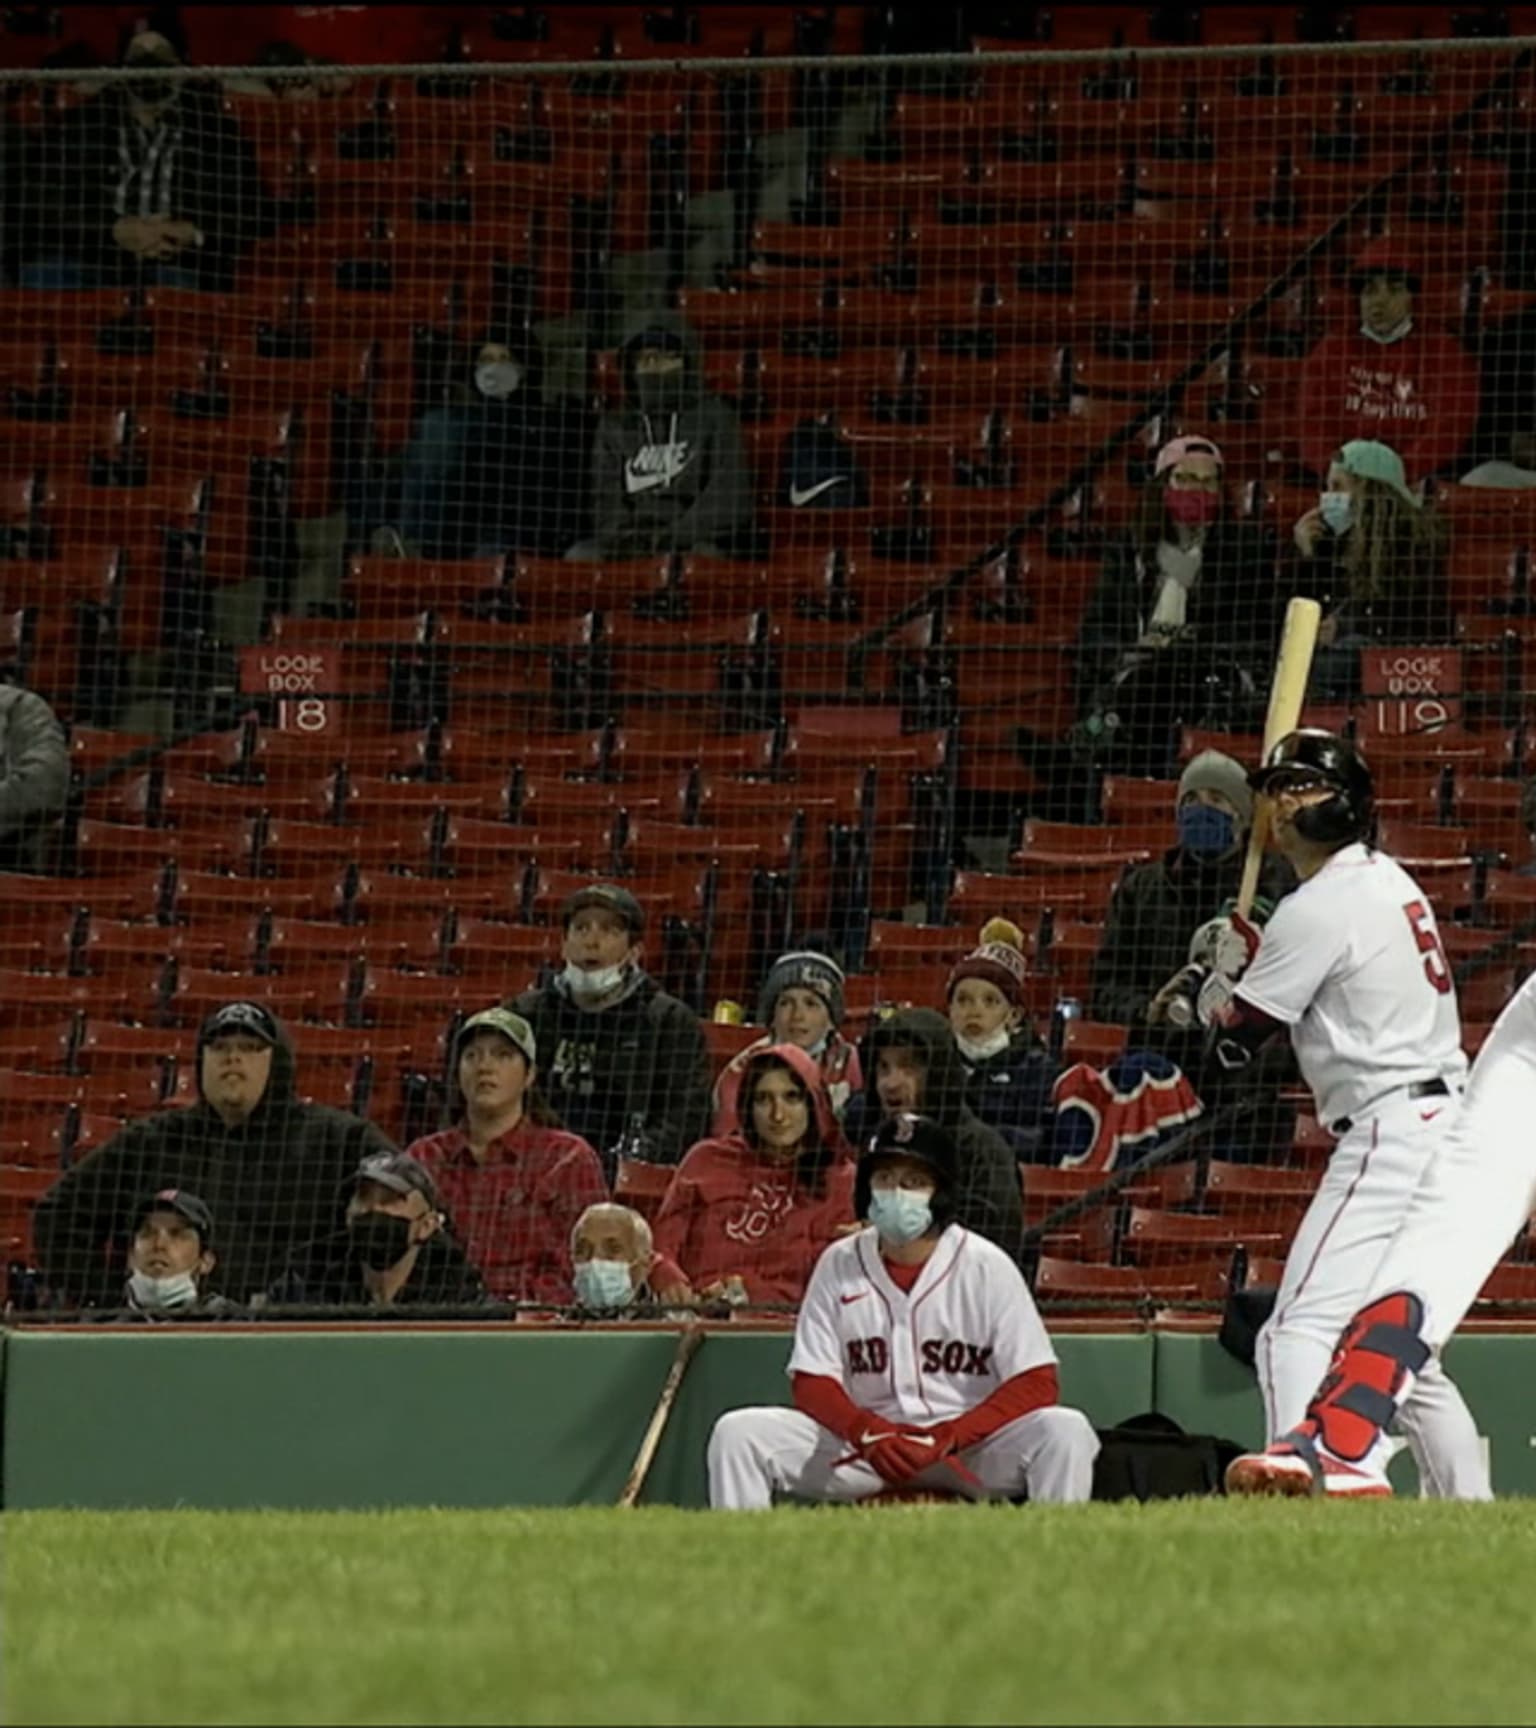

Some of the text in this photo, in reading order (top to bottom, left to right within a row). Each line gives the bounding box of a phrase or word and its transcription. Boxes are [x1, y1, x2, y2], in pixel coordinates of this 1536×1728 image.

[261, 654, 324, 673] LOGE
[1380, 656, 1443, 676] LOGE
[268, 673, 316, 692] BOX
[1388, 677, 1439, 696] BOX
[1378, 700, 1448, 734] 119
[1402, 899, 1451, 995] 5
[921, 1340, 994, 1376] SOX
